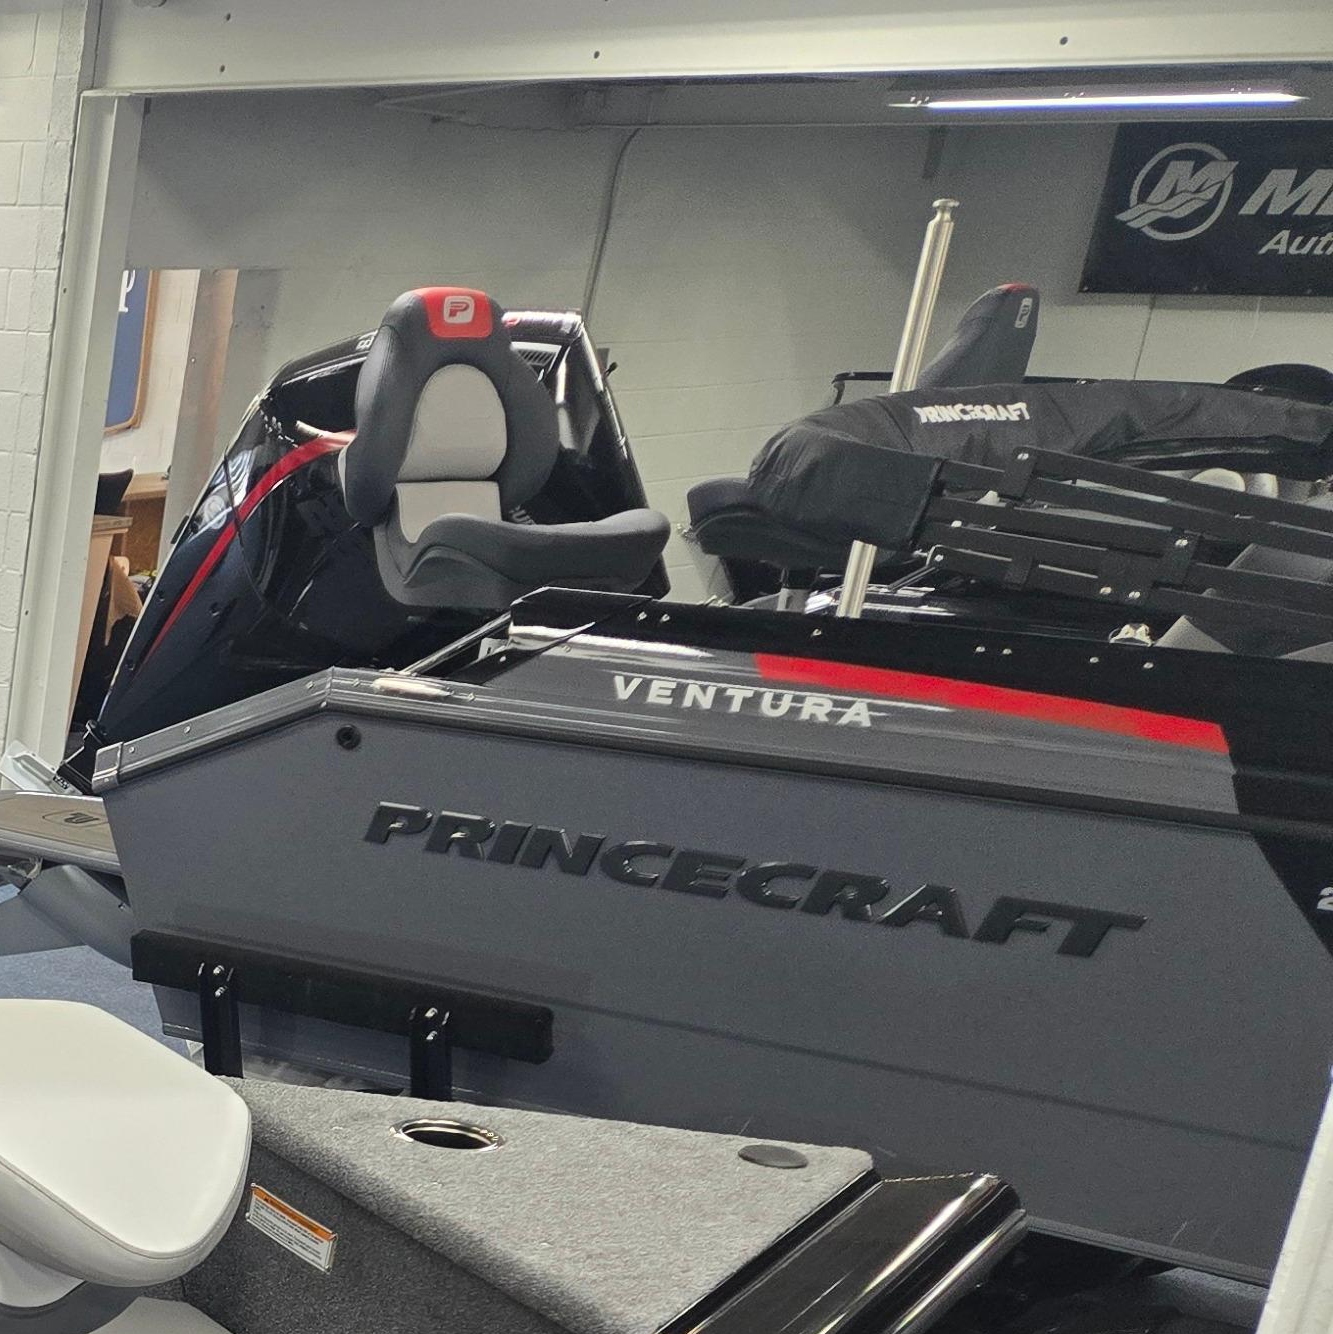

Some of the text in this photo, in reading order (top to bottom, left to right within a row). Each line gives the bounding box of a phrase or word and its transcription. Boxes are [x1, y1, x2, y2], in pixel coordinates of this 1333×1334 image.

[1258, 229, 1333, 255] Aut
[613, 675, 873, 728] VENTURA
[363, 800, 1149, 959] PRINCECRAFT
